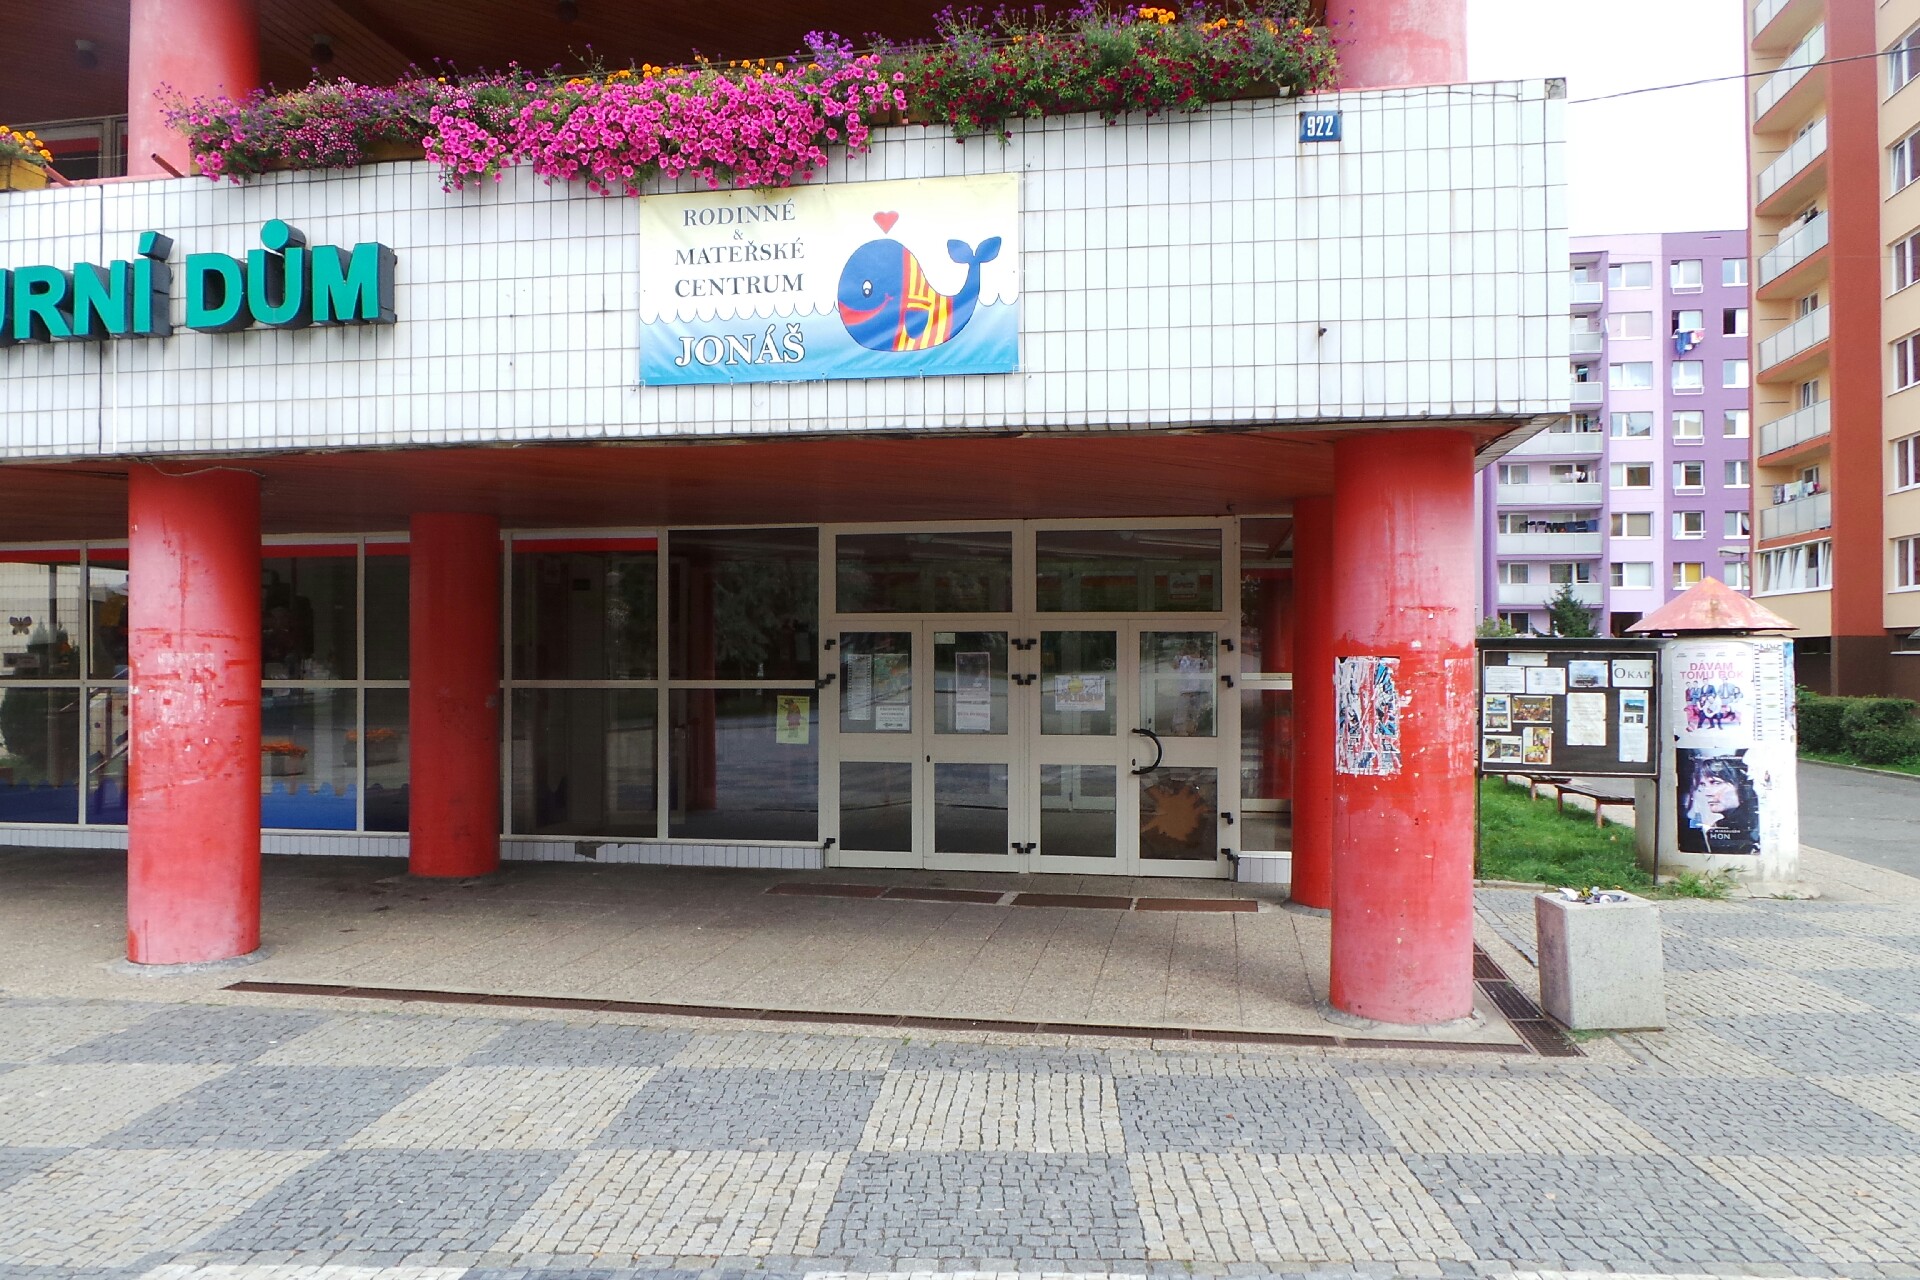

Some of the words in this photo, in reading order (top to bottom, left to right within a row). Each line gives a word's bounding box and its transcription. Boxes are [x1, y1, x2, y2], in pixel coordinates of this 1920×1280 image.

[1307, 115, 1334, 137] 922
[683, 198, 796, 227] RODINNÉ
[733, 228, 744, 241] &
[674, 237, 805, 266] MATEŘSKÉ
[0, 231, 162, 342] RNÍ
[185, 218, 392, 333] DŮM
[674, 273, 805, 298] CENTRUM
[674, 322, 805, 367] JONÁŠ
[1680, 671, 1714, 680] TOMU
